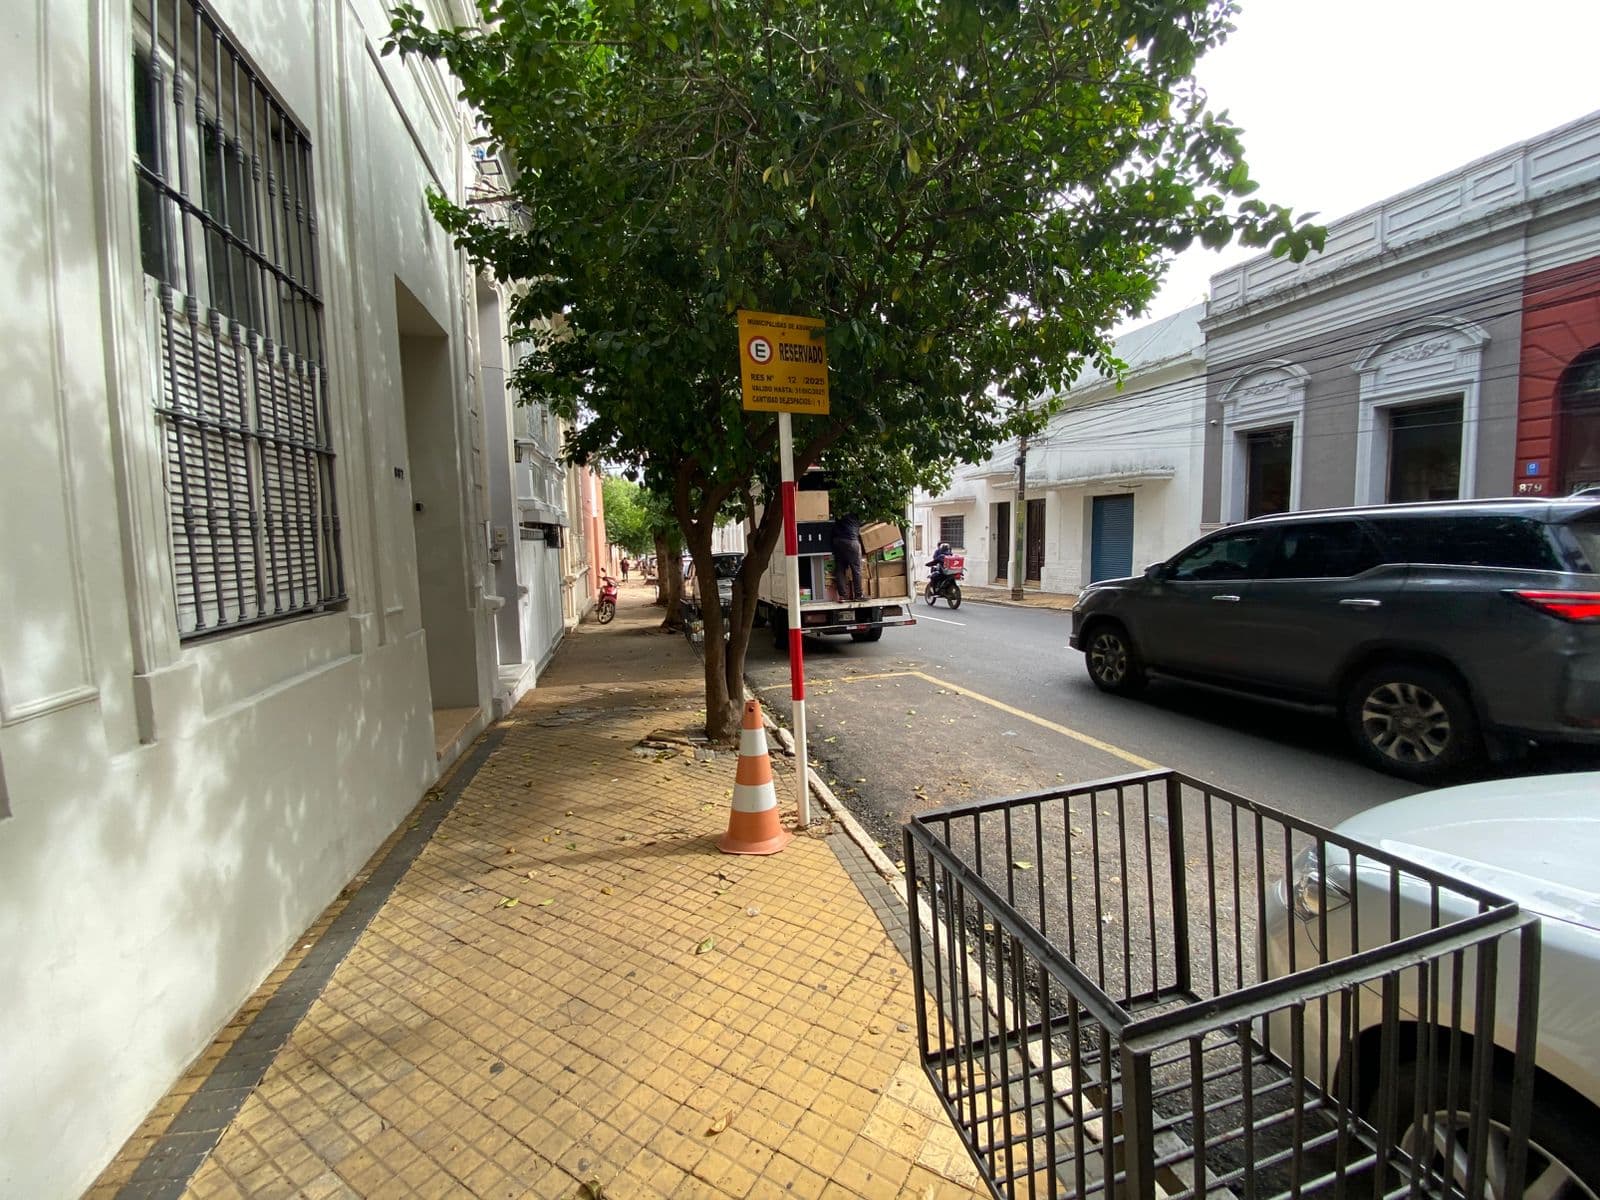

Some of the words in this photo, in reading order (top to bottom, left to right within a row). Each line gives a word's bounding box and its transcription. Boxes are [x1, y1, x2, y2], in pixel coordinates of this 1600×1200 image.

[755, 343, 766, 358] E
[779, 343, 823, 364] RESERVADO
[788, 376, 797, 384] 12
[1519, 483, 1542, 492] 879
